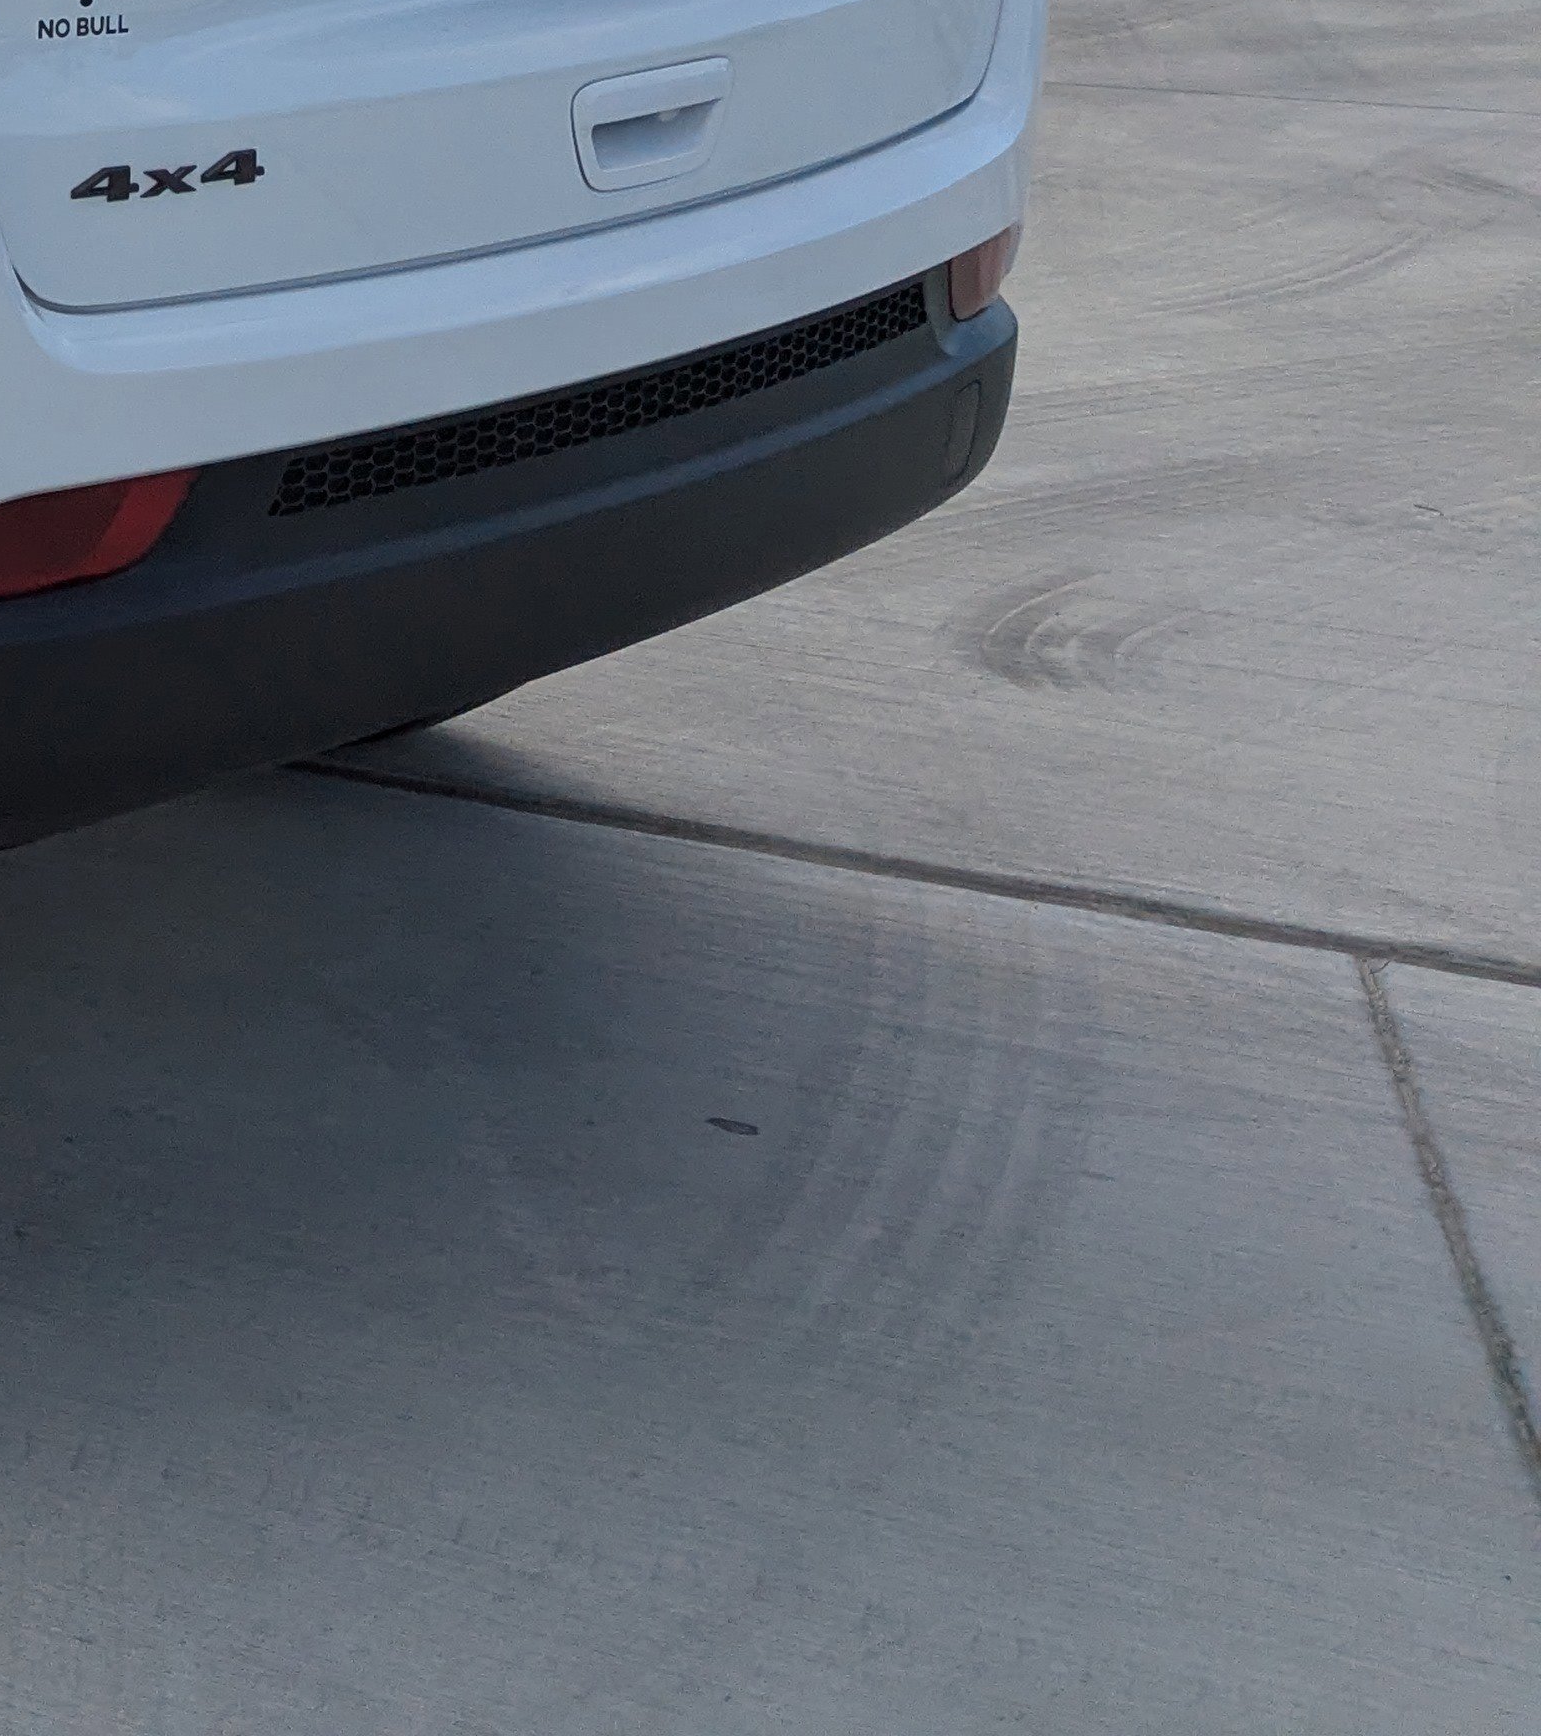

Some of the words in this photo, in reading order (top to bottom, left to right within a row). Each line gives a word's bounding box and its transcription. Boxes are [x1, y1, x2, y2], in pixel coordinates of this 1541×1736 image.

[37, 18, 71, 39] NO
[76, 14, 129, 37] BULL
[70, 148, 265, 202] 4x4
